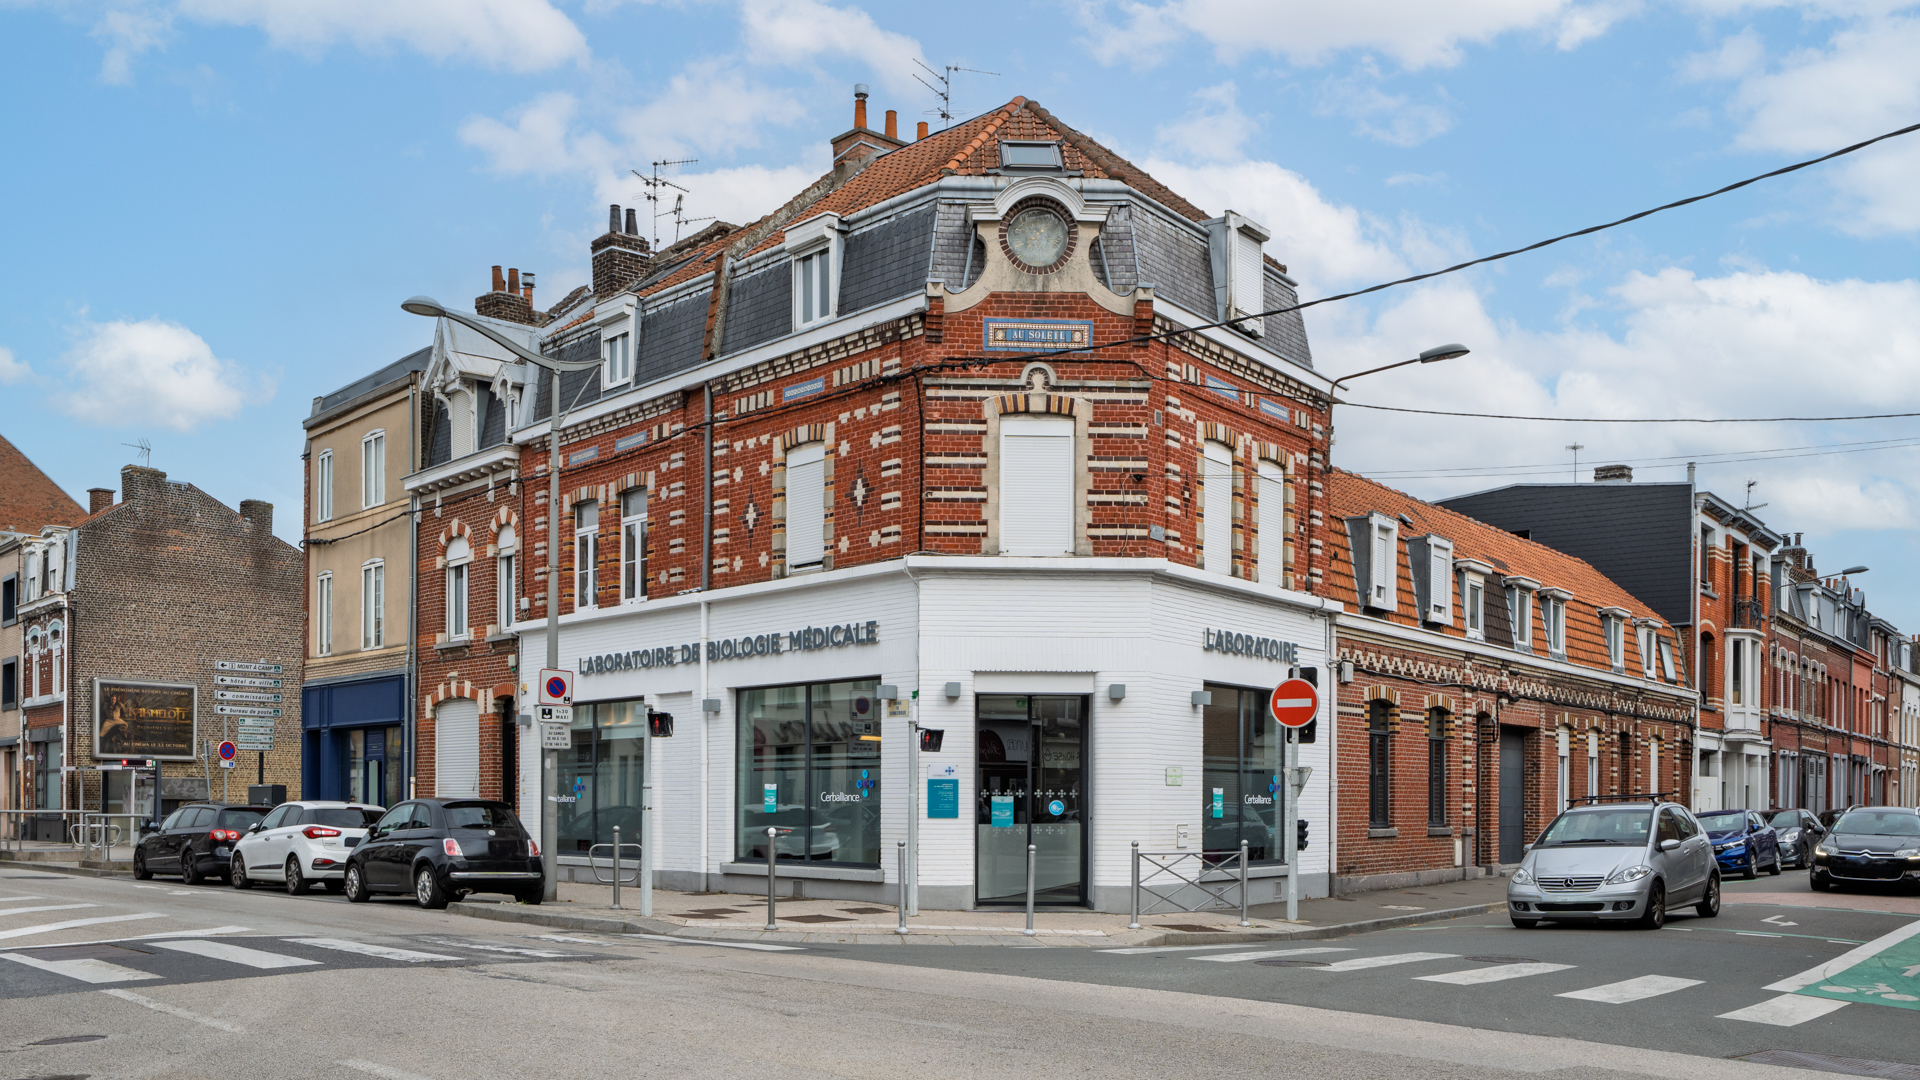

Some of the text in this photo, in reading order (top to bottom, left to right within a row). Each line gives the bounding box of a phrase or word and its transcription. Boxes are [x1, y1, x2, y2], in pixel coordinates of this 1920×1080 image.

[1012, 330, 1065, 340] AU SOLEIL
[578, 620, 877, 675] LABORATOIRE DE BIOLOGIE MÉDICALE
[1205, 627, 1299, 663] LABORATOIRE
[820, 791, 860, 802] Cerballiance
[1244, 794, 1272, 805] Cerballiance
